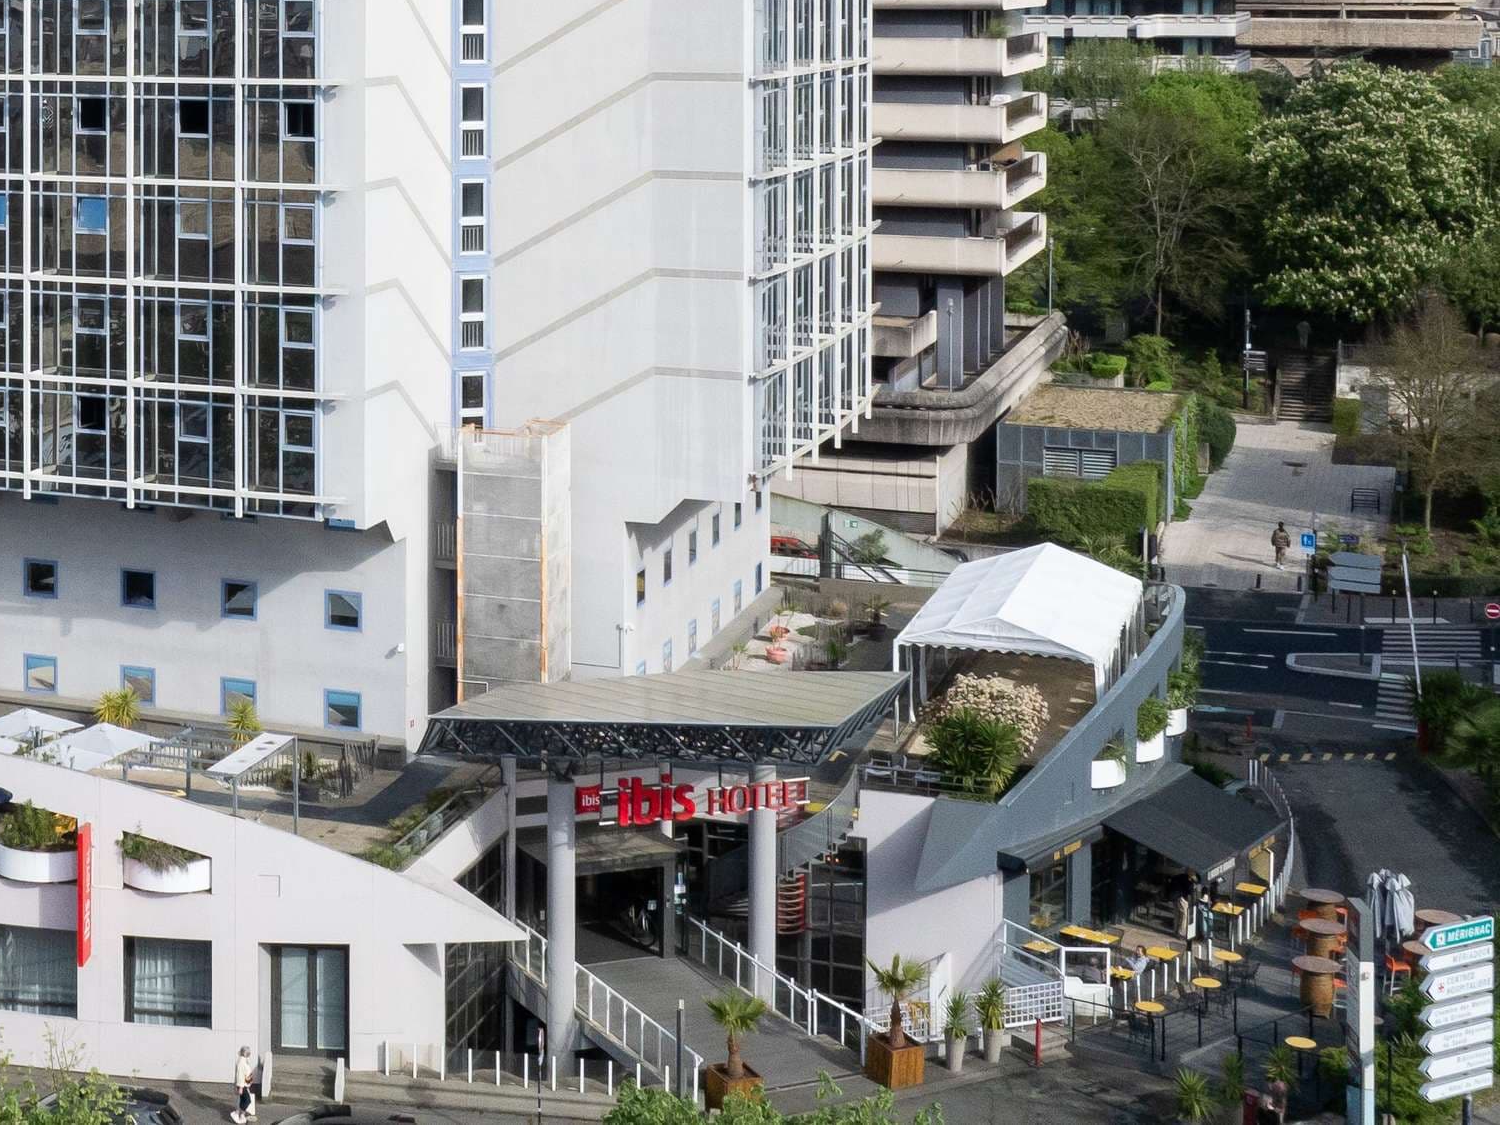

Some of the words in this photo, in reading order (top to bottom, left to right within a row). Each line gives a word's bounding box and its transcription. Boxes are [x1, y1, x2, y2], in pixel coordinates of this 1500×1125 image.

[582, 794, 601, 806] ibis
[617, 773, 696, 827] ibis
[1447, 923, 1492, 942] MÉRIGNAC
